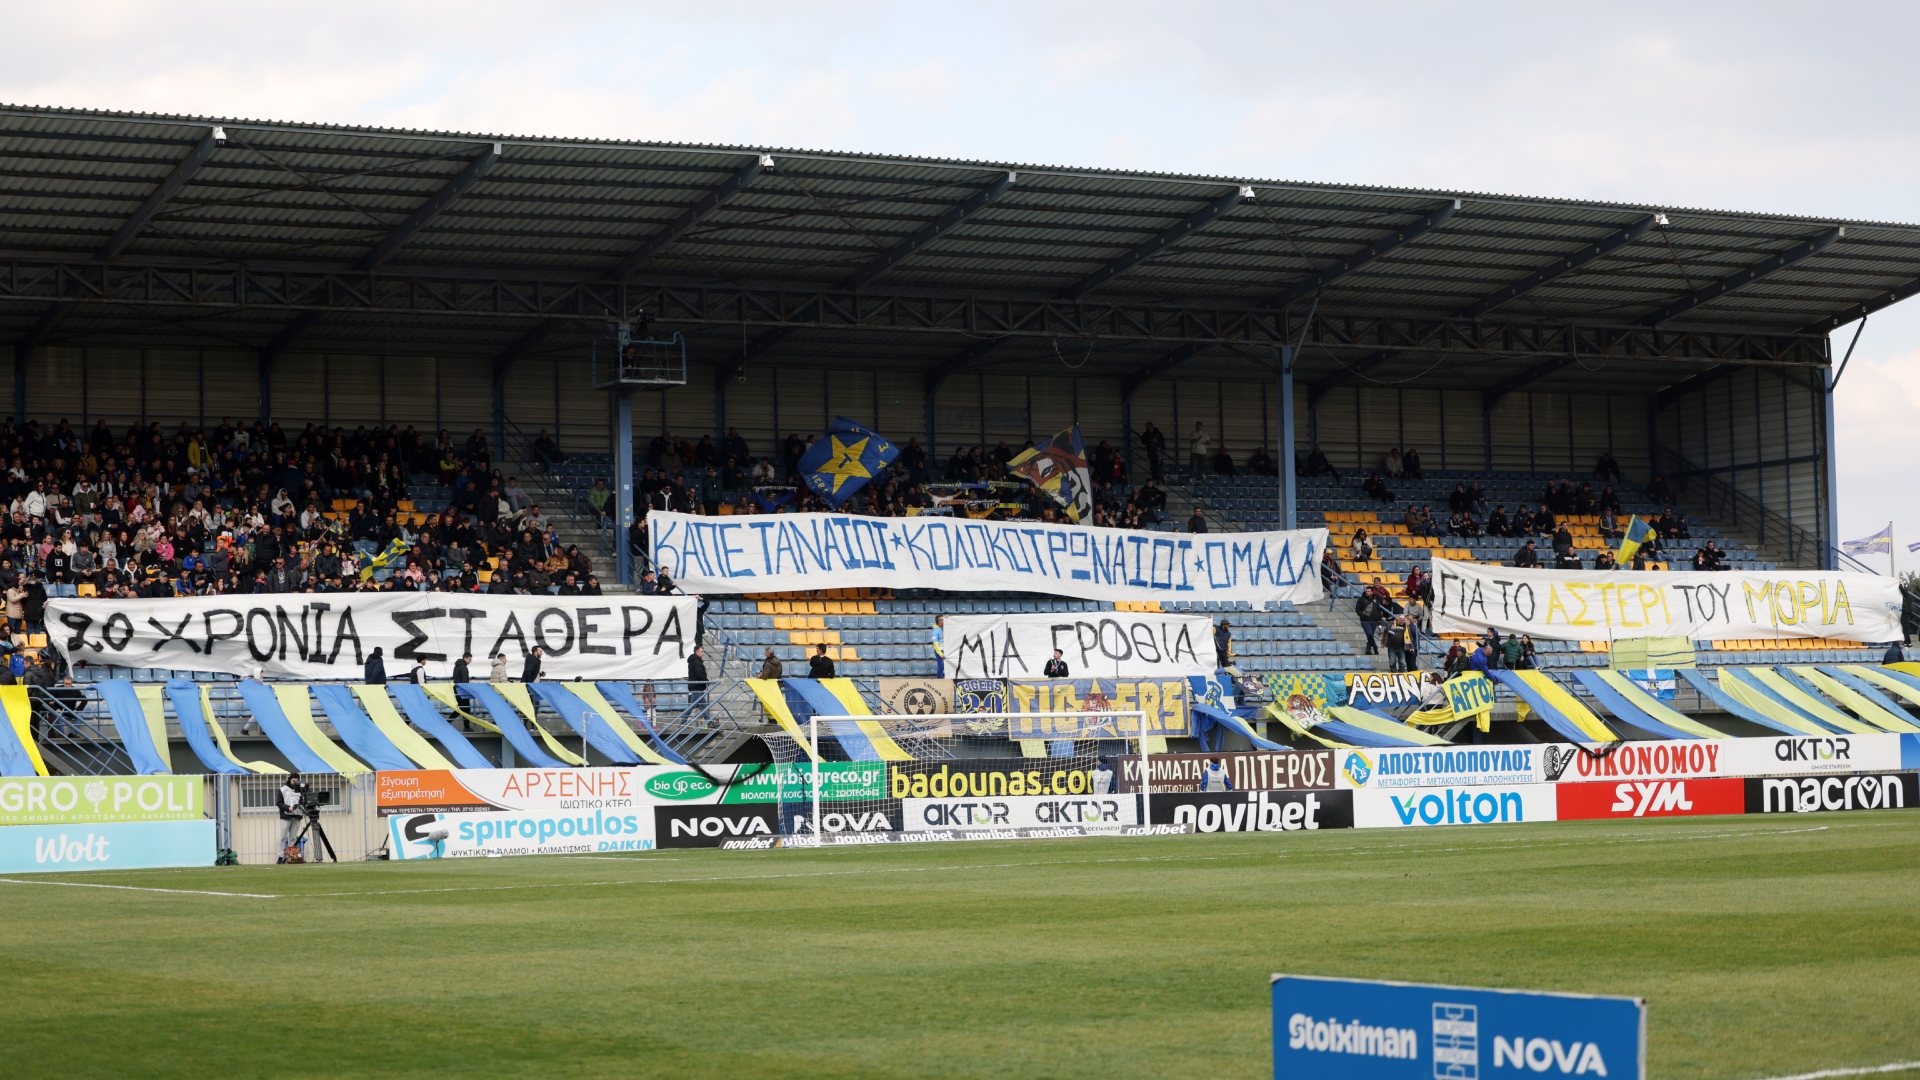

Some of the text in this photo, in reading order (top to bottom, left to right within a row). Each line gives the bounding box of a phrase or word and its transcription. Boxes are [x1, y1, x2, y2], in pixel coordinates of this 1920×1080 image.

[1205, 537, 1316, 590] ΟΜΑΔΑ
[1440, 574, 1854, 628] ΓΙΑ ΤΟ ΑΣΤΕΡΙ ΤΟΥ ΜΟΡΙΑ
[60, 602, 686, 666] 20 ΧΡΟΝΙΑ ΣΤΑΘΕΡΑ
[956, 618, 1200, 679] ΜΙΑ ΓΡΟΘΙΑ
[957, 679, 1004, 692] TIGERS
[1012, 682, 1185, 733] TIGERS
[1234, 753, 1331, 790] ΠΙΤΕΡΟΣ
[1378, 750, 1532, 776] ΑΠΟΣΤΟΛΟΠΟΥΛΟΣ
[1576, 744, 1719, 777] ΟΙΚΟΝΟΜΟΥ
[381, 776, 418, 788] Σίγουρη
[502, 772, 632, 798] ΑΡΣΕΝΗΣ
[1377, 777, 1421, 788] ΜΕΤΑΦΟΡΕΣ
[1611, 781, 1693, 817] SYM
[1763, 775, 1904, 812] macron
[560, 799, 602, 809] ΙΔΙΩΤΙΚΟ
[1174, 790, 1321, 833] novibet
[1390, 788, 1523, 826] volton
[459, 810, 638, 847] spiropoulos
[671, 816, 772, 838] NOVA
[723, 836, 775, 849] novibet
[900, 830, 955, 842] novibet
[35, 832, 110, 864] Wolt
[597, 840, 653, 851] DAIKIN
[1288, 1012, 1418, 1060] Stoiximan
[1493, 1035, 1608, 1077] NOVA
